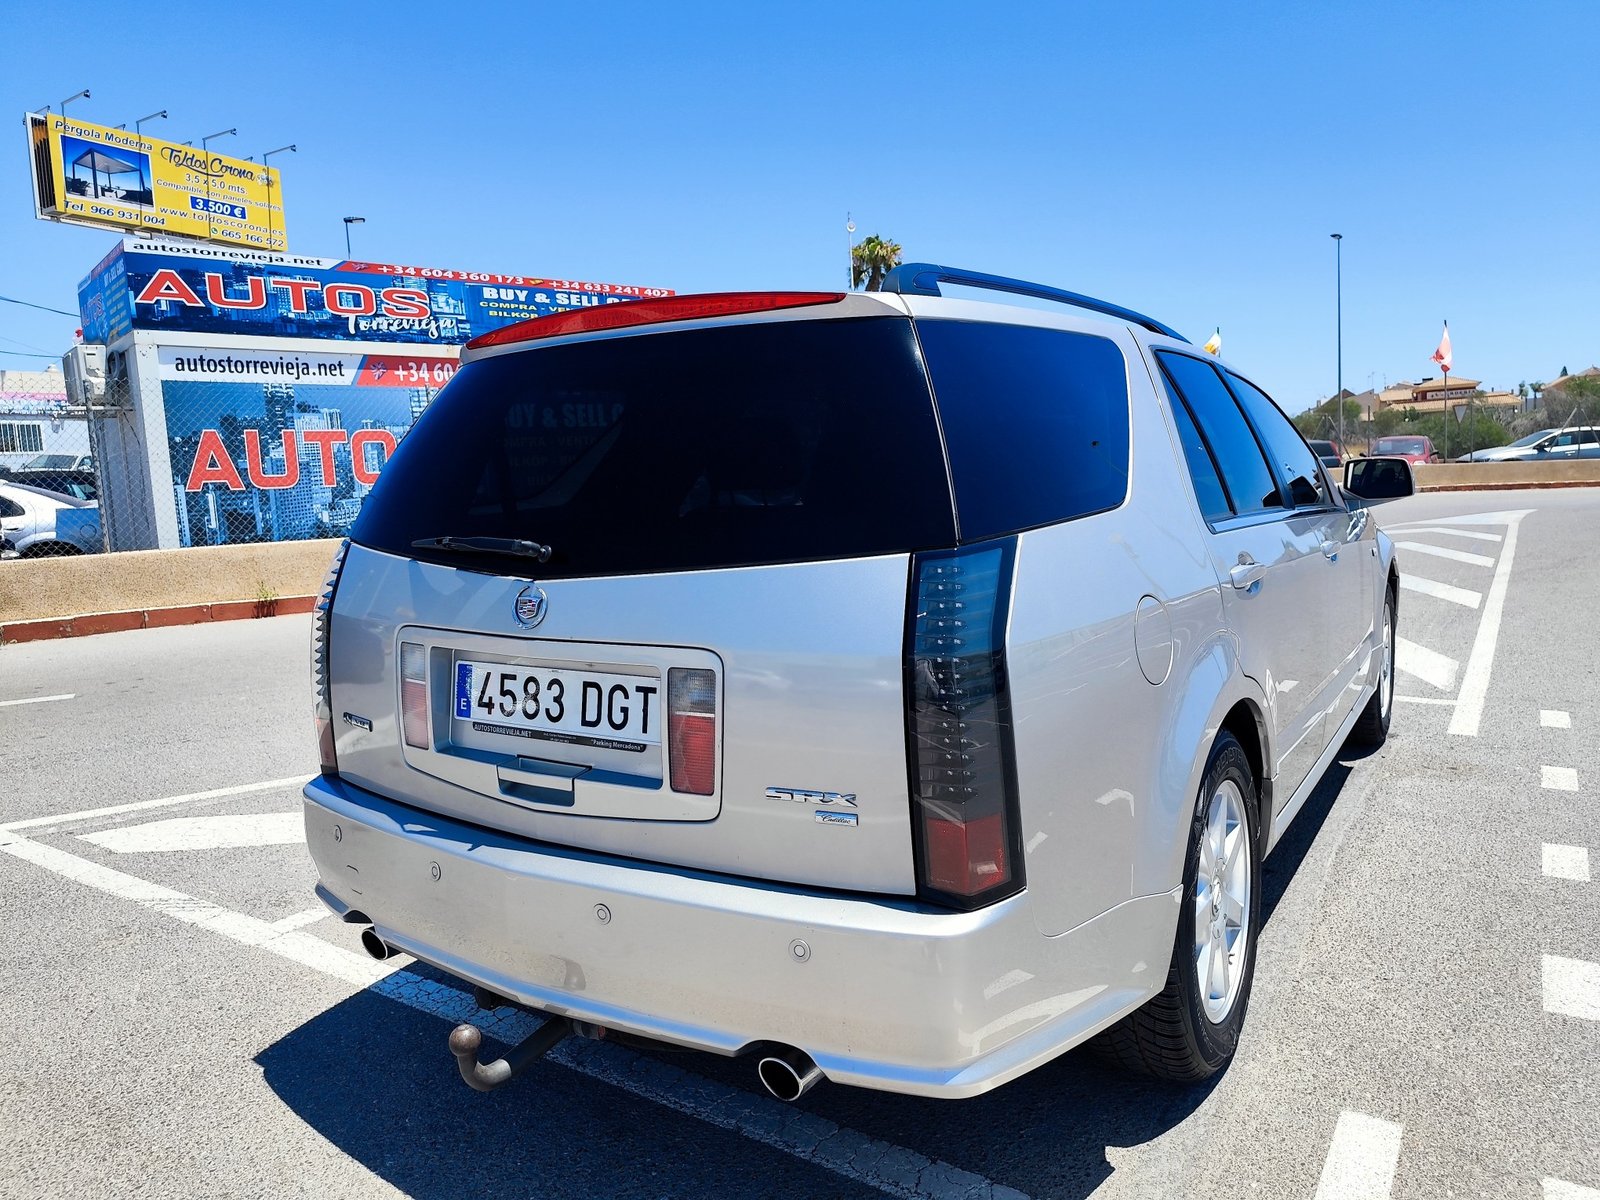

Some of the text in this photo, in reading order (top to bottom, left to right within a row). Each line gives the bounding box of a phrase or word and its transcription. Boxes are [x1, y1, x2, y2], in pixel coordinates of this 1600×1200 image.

[105, 132, 153, 151] Moderna
[160, 146, 255, 182] Toldos Corona
[156, 179, 204, 195] Compatible
[205, 190, 221, 198] con
[222, 194, 253, 205] paneles
[64, 200, 166, 226] Tel. 966 931 004
[195, 198, 243, 218] 3.500 €
[159, 206, 284, 236] www.toldoscorona.es
[221, 229, 284, 247] 665 166 572
[133, 243, 323, 267] autostorrevieja.net
[378, 265, 525, 285] +34 604 360 173
[135, 268, 430, 319] AUTOS
[482, 286, 529, 302] BUY
[534, 292, 551, 304] &
[555, 293, 600, 307] SELL
[549, 280, 669, 297] +34 633 241 402
[479, 301, 538, 311] COMPRA
[346, 313, 458, 340] Torrevieja
[174, 356, 345, 381] autostorrevieja.net
[393, 361, 460, 383] +34 60
[460, 698, 468, 710] E
[477, 671, 658, 735] 4583 DGT
[474, 723, 533, 739] AUTOSTORREVIEJA.NET
[765, 786, 858, 808] SRX
[820, 814, 851, 825] Cadillac
